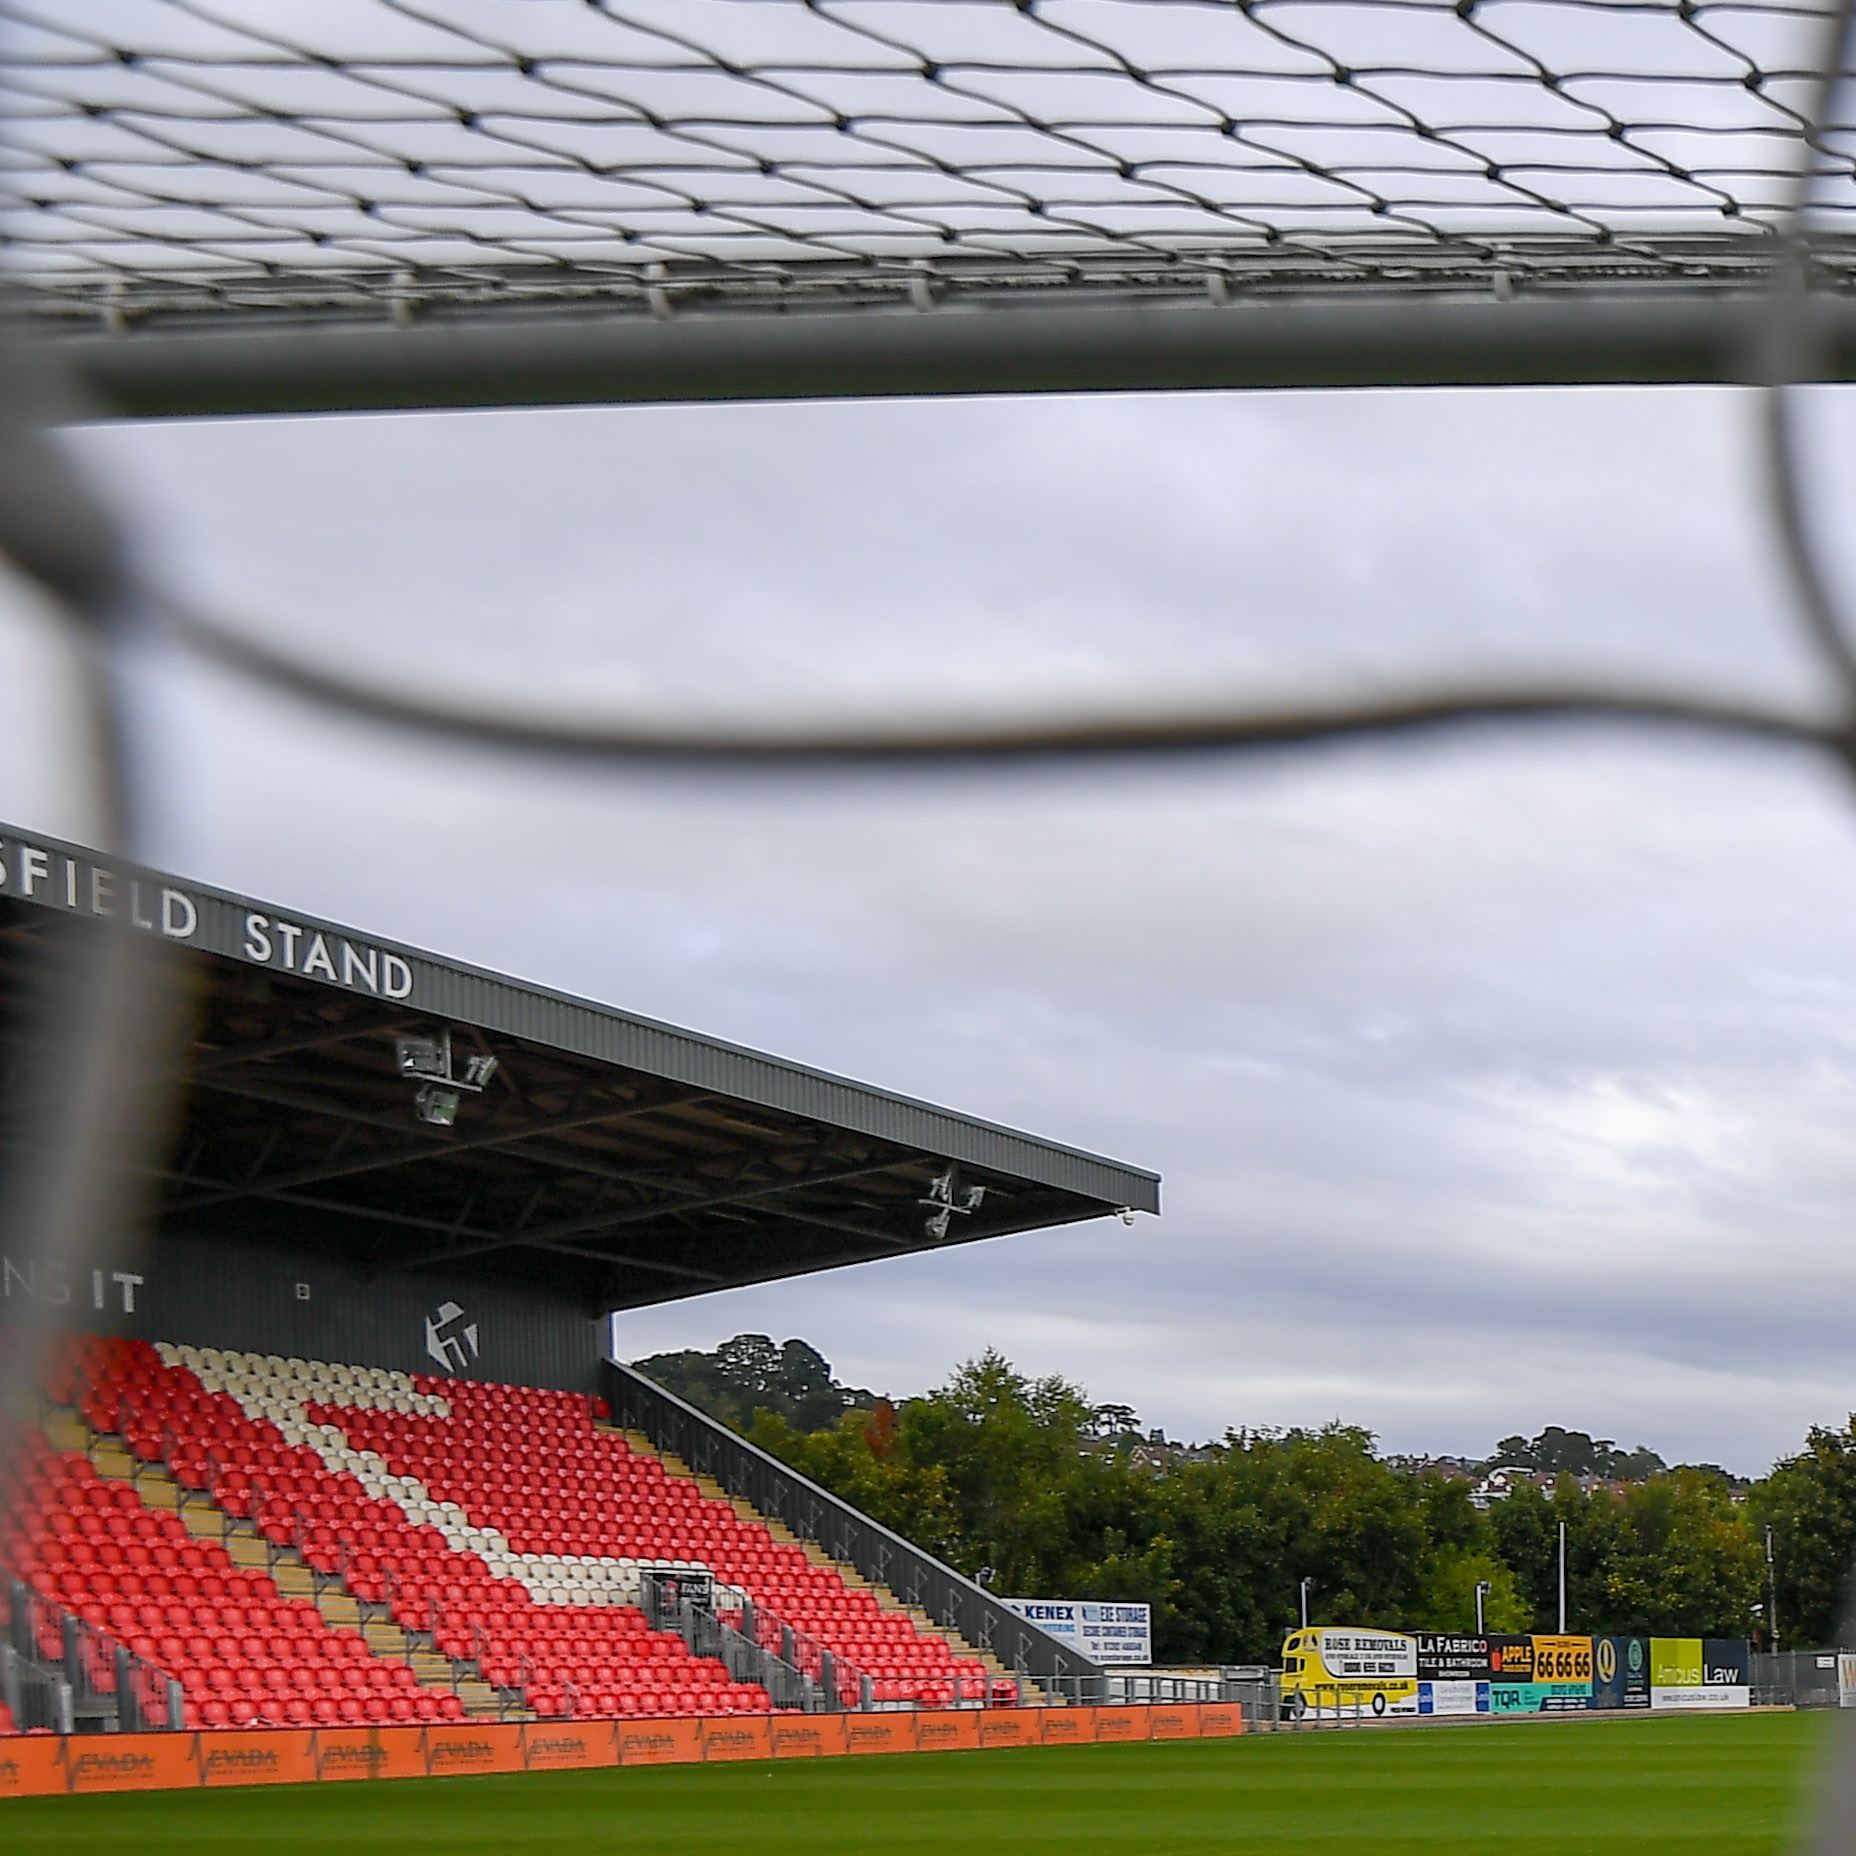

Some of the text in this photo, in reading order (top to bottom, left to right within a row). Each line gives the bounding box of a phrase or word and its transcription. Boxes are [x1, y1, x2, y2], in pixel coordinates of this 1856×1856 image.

[0, 835, 413, 999] FIELD STAND
[93, 1269, 144, 1313] IT
[1024, 1604, 1074, 1620] KENEX
[1324, 1638, 1407, 1651] ROSE REMOVALS
[1503, 1646, 1533, 1662] APPLE
[1537, 1652, 1590, 1678] 66 66 66
[1657, 1663, 1740, 1684] Amicus Law
